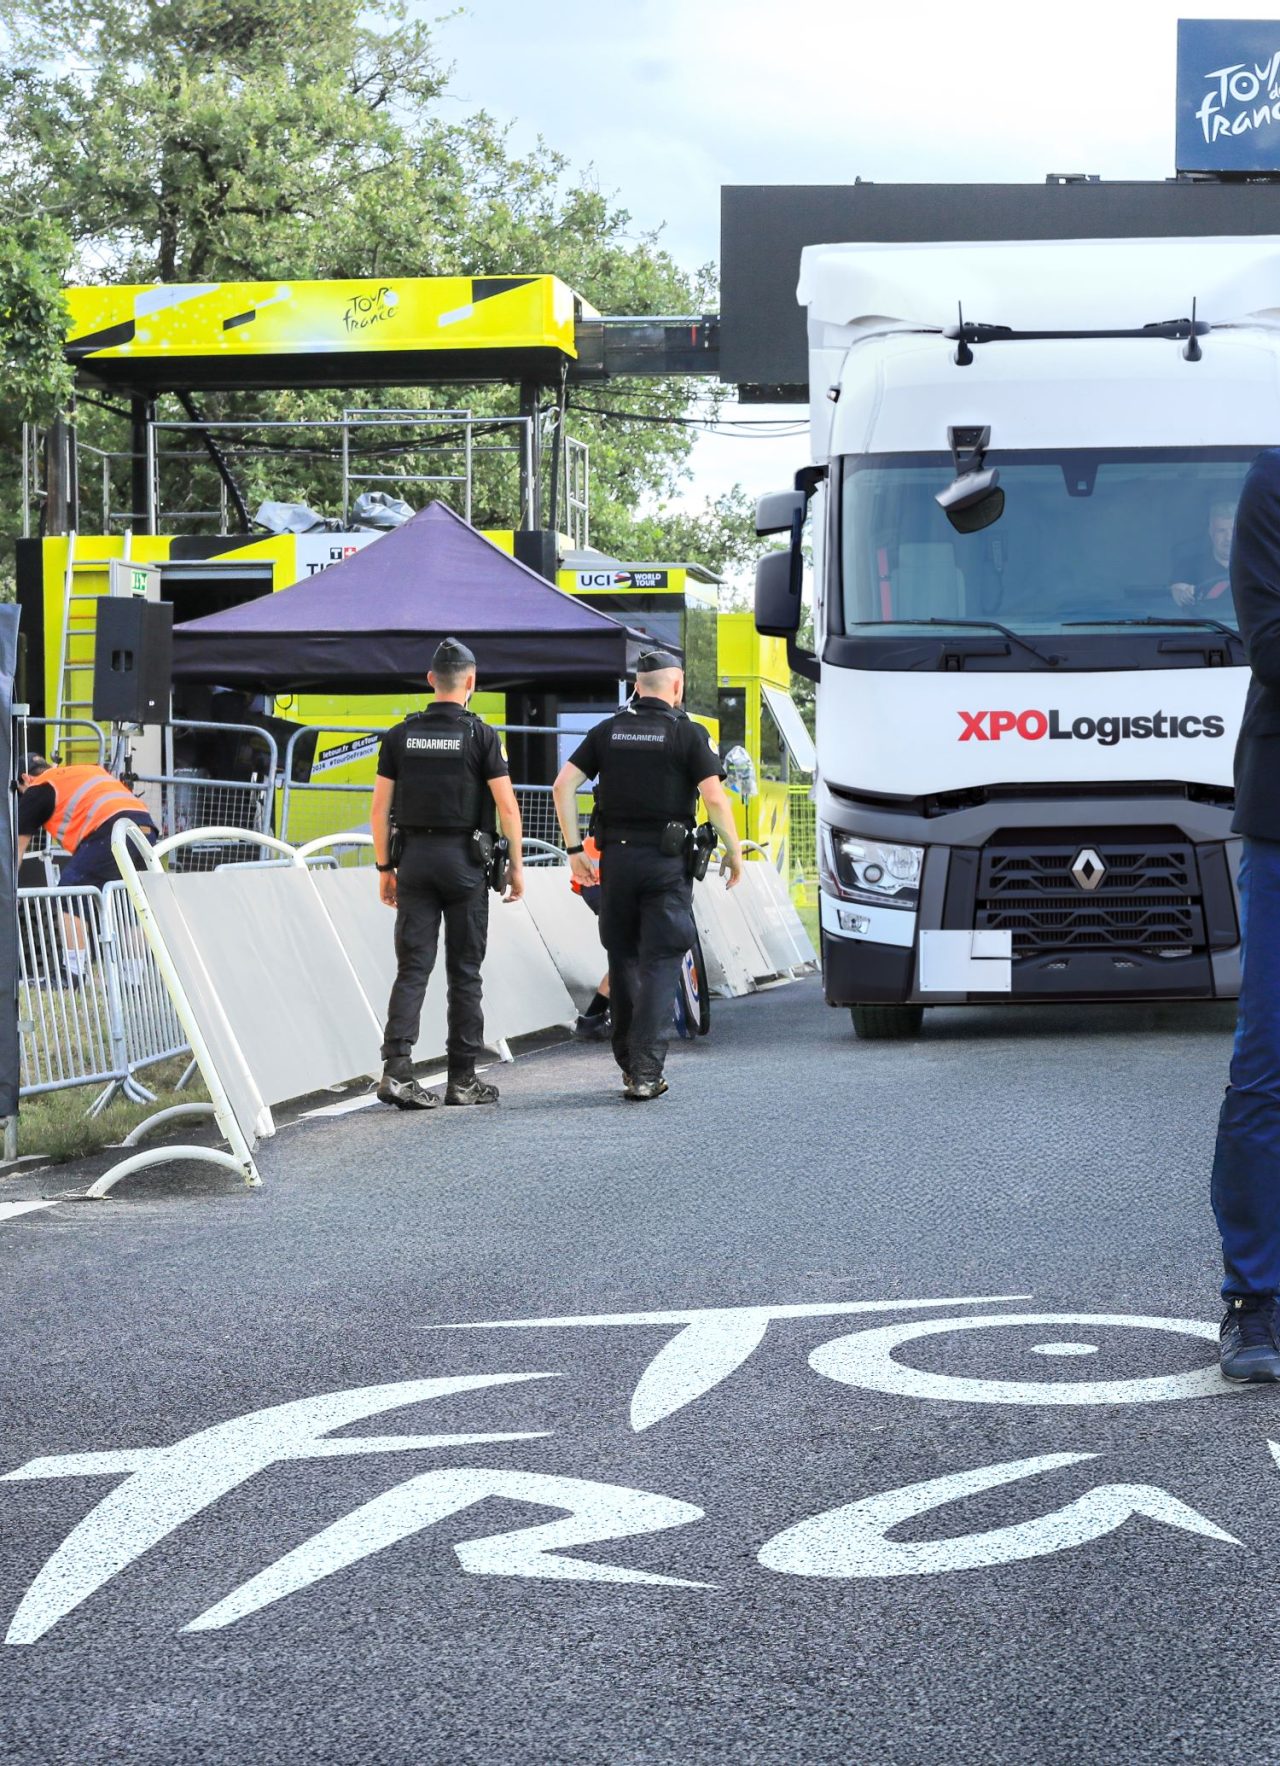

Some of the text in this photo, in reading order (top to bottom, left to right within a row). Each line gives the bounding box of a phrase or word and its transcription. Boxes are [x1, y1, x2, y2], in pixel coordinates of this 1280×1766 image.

[581, 575, 611, 586] UCI
[611, 733, 665, 743] GENDARMERIE
[406, 738, 461, 750] GENDARMERIE
